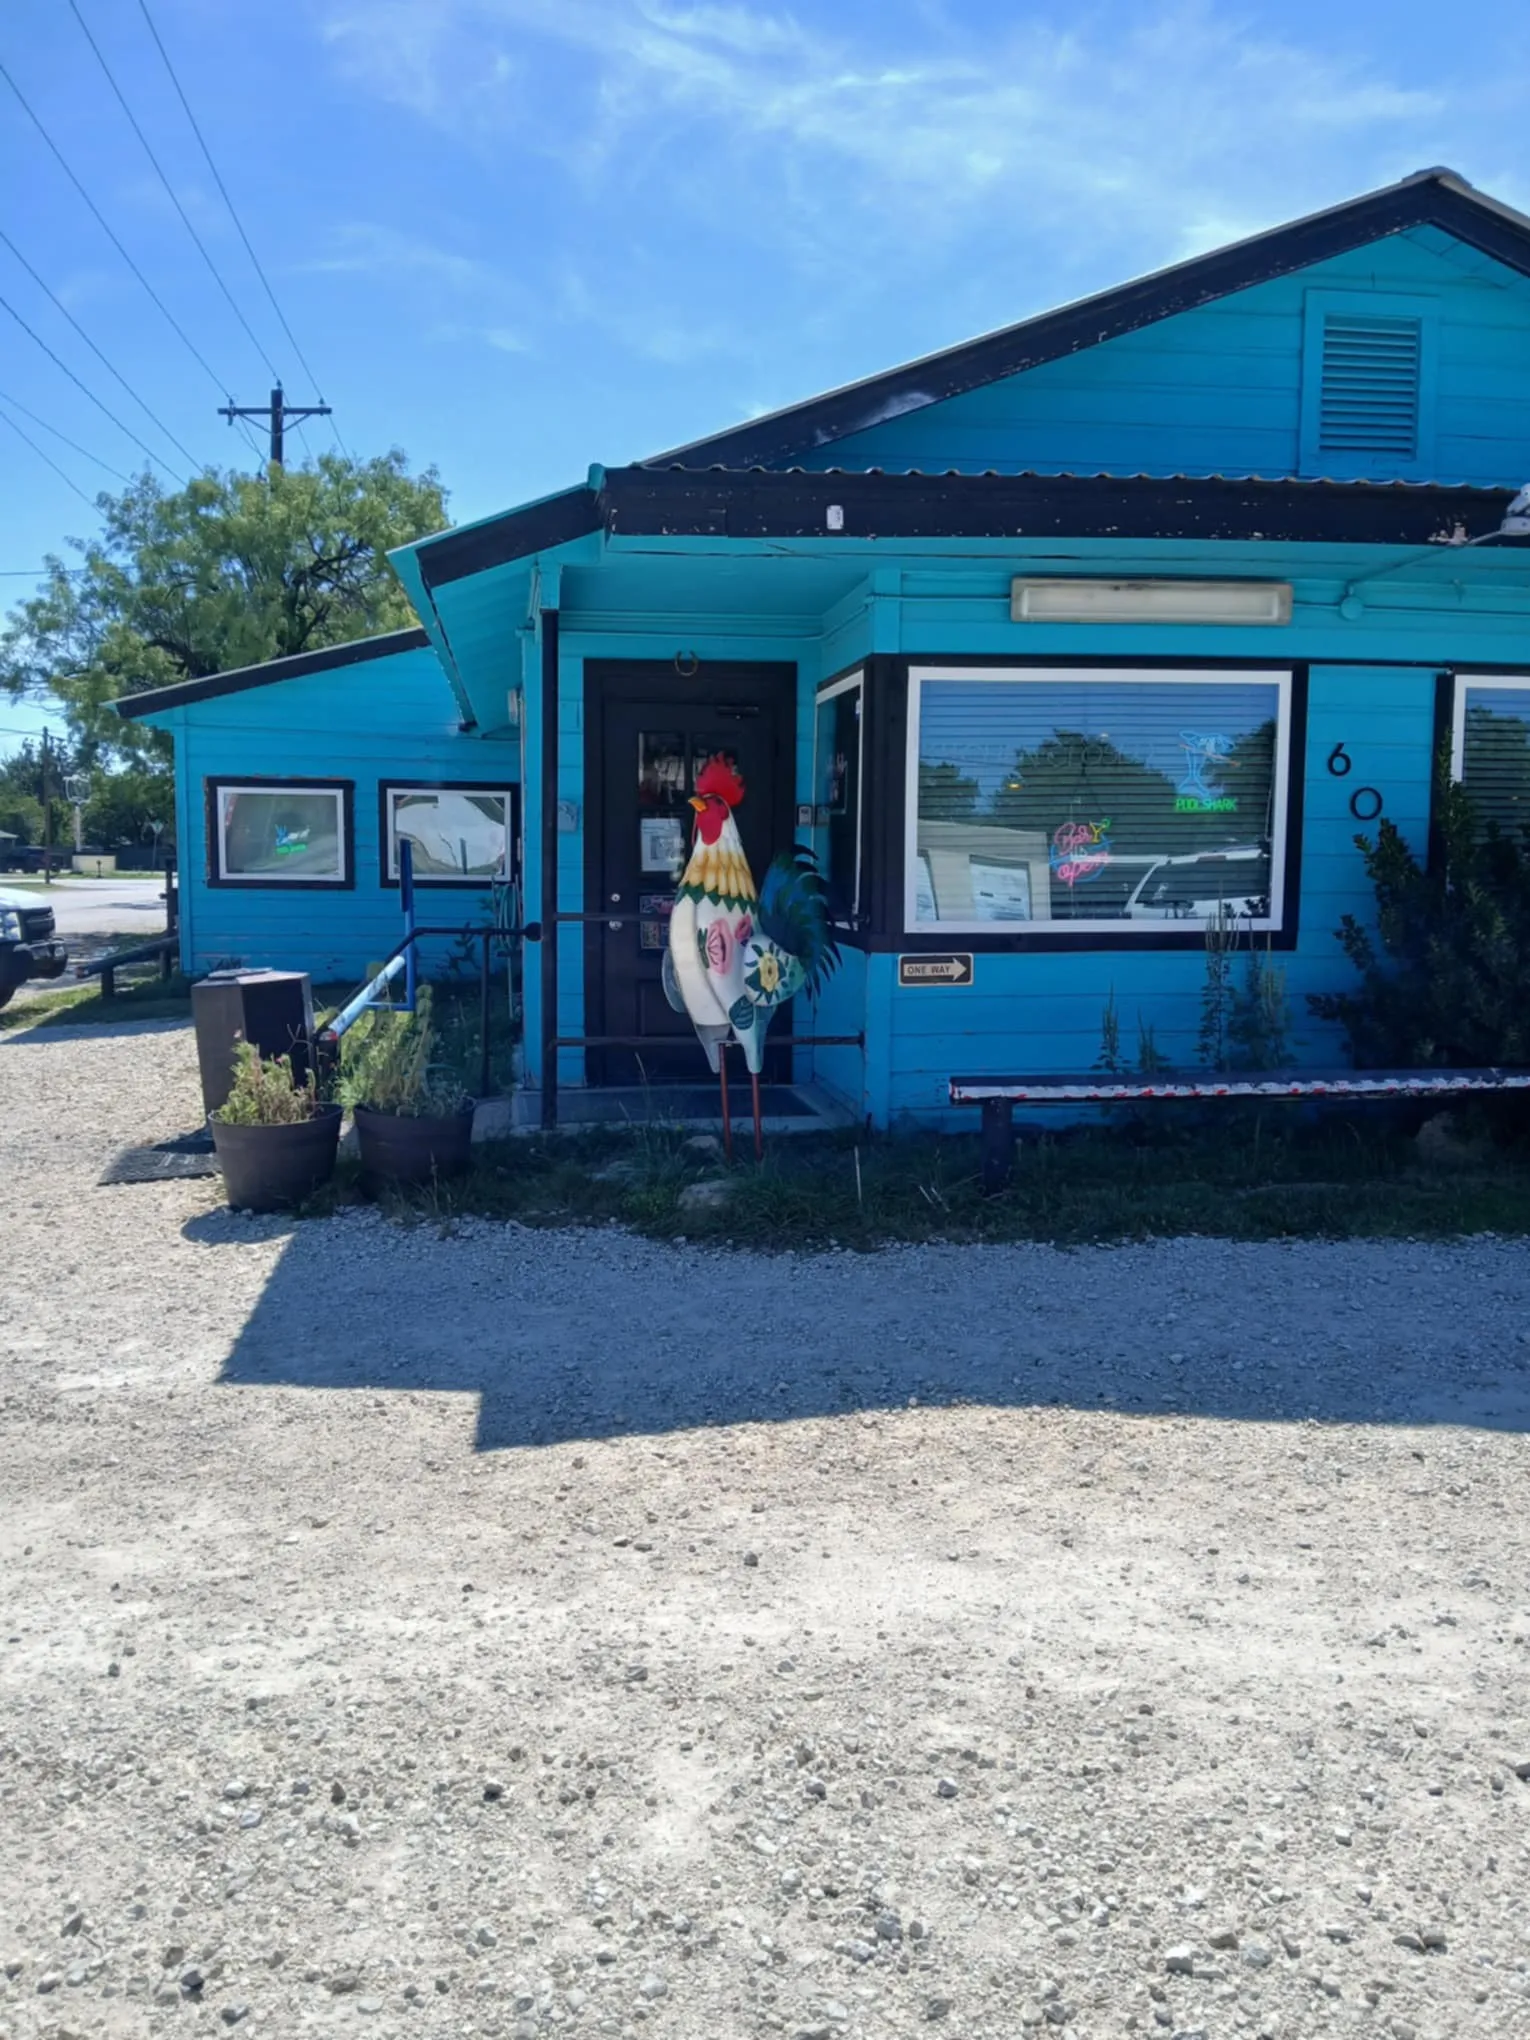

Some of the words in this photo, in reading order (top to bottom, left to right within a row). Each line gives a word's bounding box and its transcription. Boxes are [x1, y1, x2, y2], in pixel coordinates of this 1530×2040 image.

[1327, 742, 1352, 777] 6
[1203, 798, 1238, 812] SHARK
[907, 965, 927, 975] ONE
[931, 964, 951, 974] WAY
